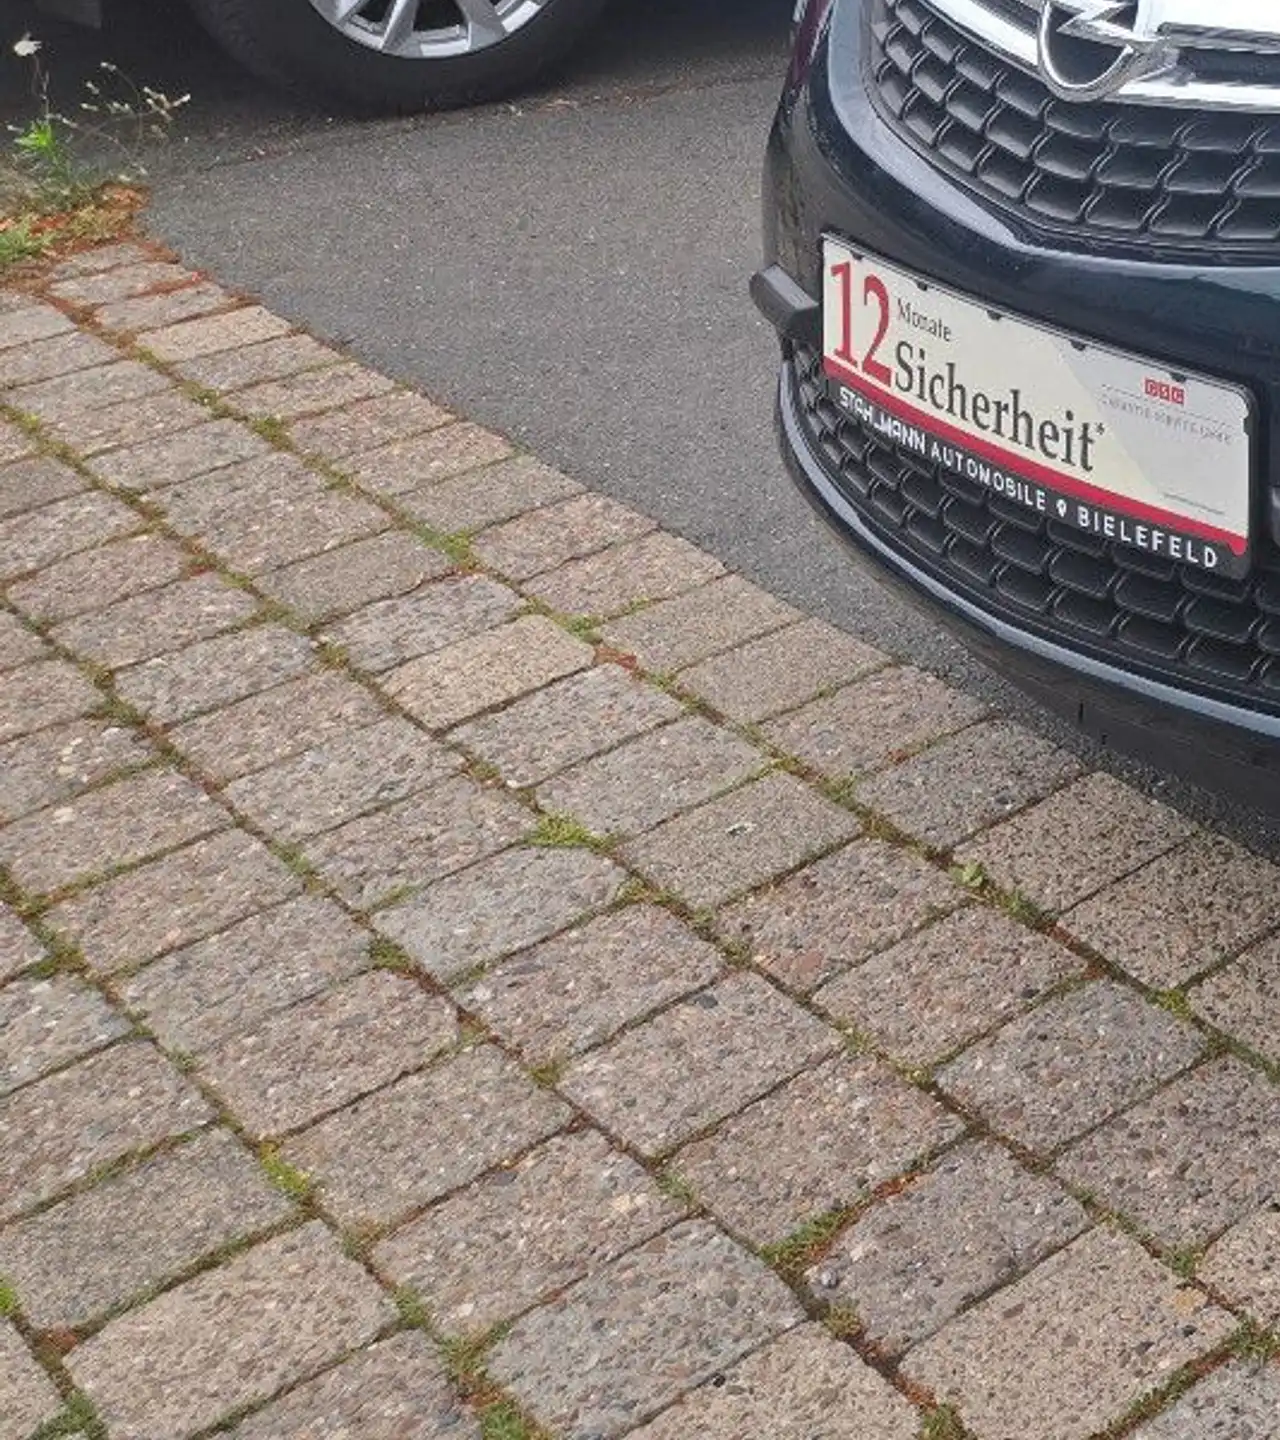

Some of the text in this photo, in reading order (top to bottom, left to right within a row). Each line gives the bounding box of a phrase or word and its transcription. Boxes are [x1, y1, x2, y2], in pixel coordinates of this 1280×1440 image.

[831, 262, 892, 387] 12
[897, 298, 952, 342] Monate
[839, 386, 1219, 569] STAHLMANN AUTOMOBILE BIELEFELD
